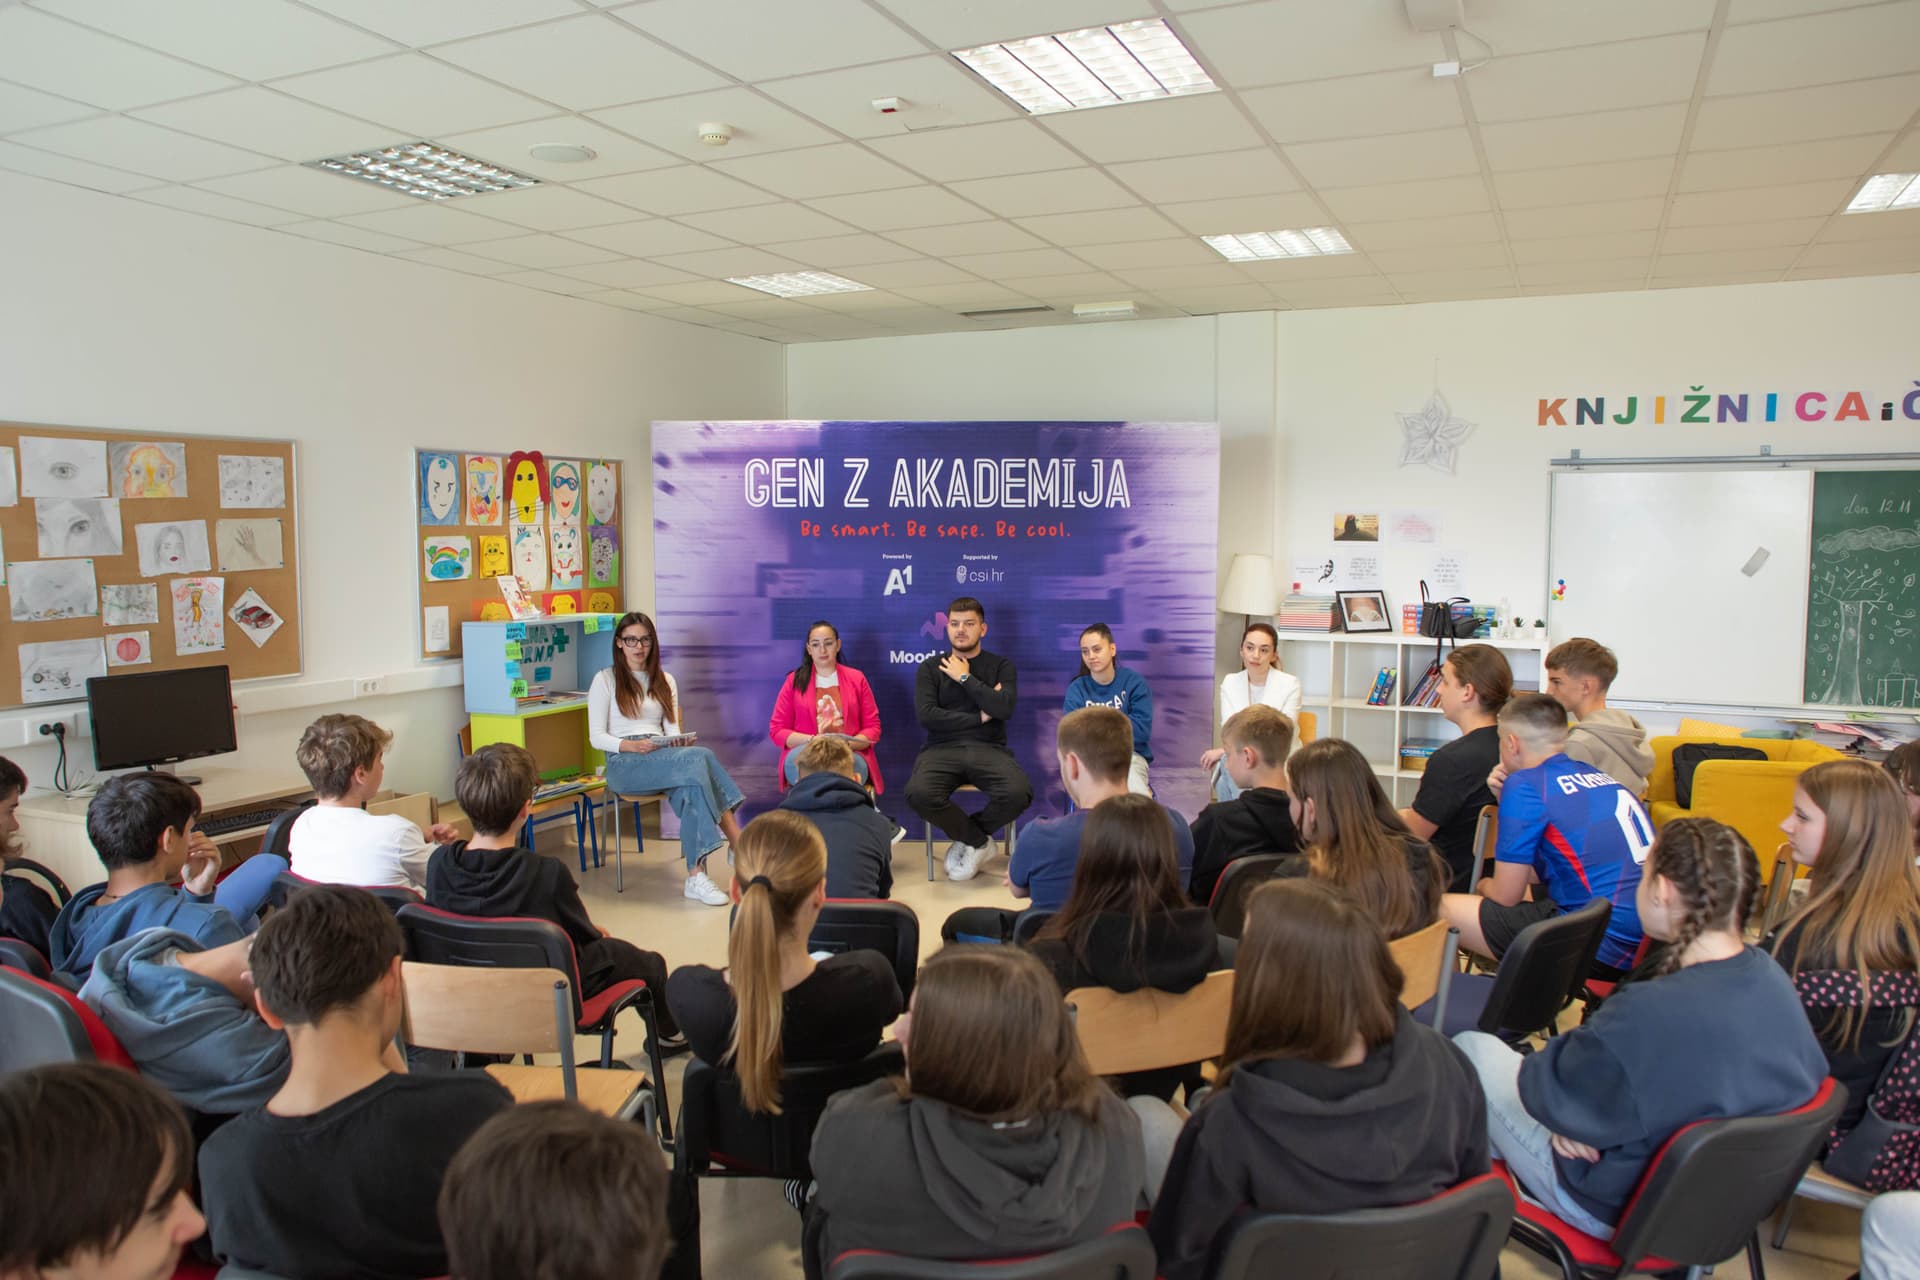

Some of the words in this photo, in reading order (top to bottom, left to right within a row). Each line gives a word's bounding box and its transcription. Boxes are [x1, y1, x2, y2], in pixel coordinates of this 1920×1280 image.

[1537, 385, 1871, 427] KNJIŽNICA
[744, 457, 825, 508] GEN
[843, 458, 870, 508] Z
[888, 457, 1131, 509] AKADEMIJA
[800, 520, 821, 537] Be
[831, 522, 895, 537] smart.
[906, 520, 927, 537] Be
[938, 522, 985, 539] safe.
[995, 520, 1016, 537] Be
[1026, 520, 1071, 538] cool.
[904, 553, 912, 561] by
[883, 565, 912, 596] A1
